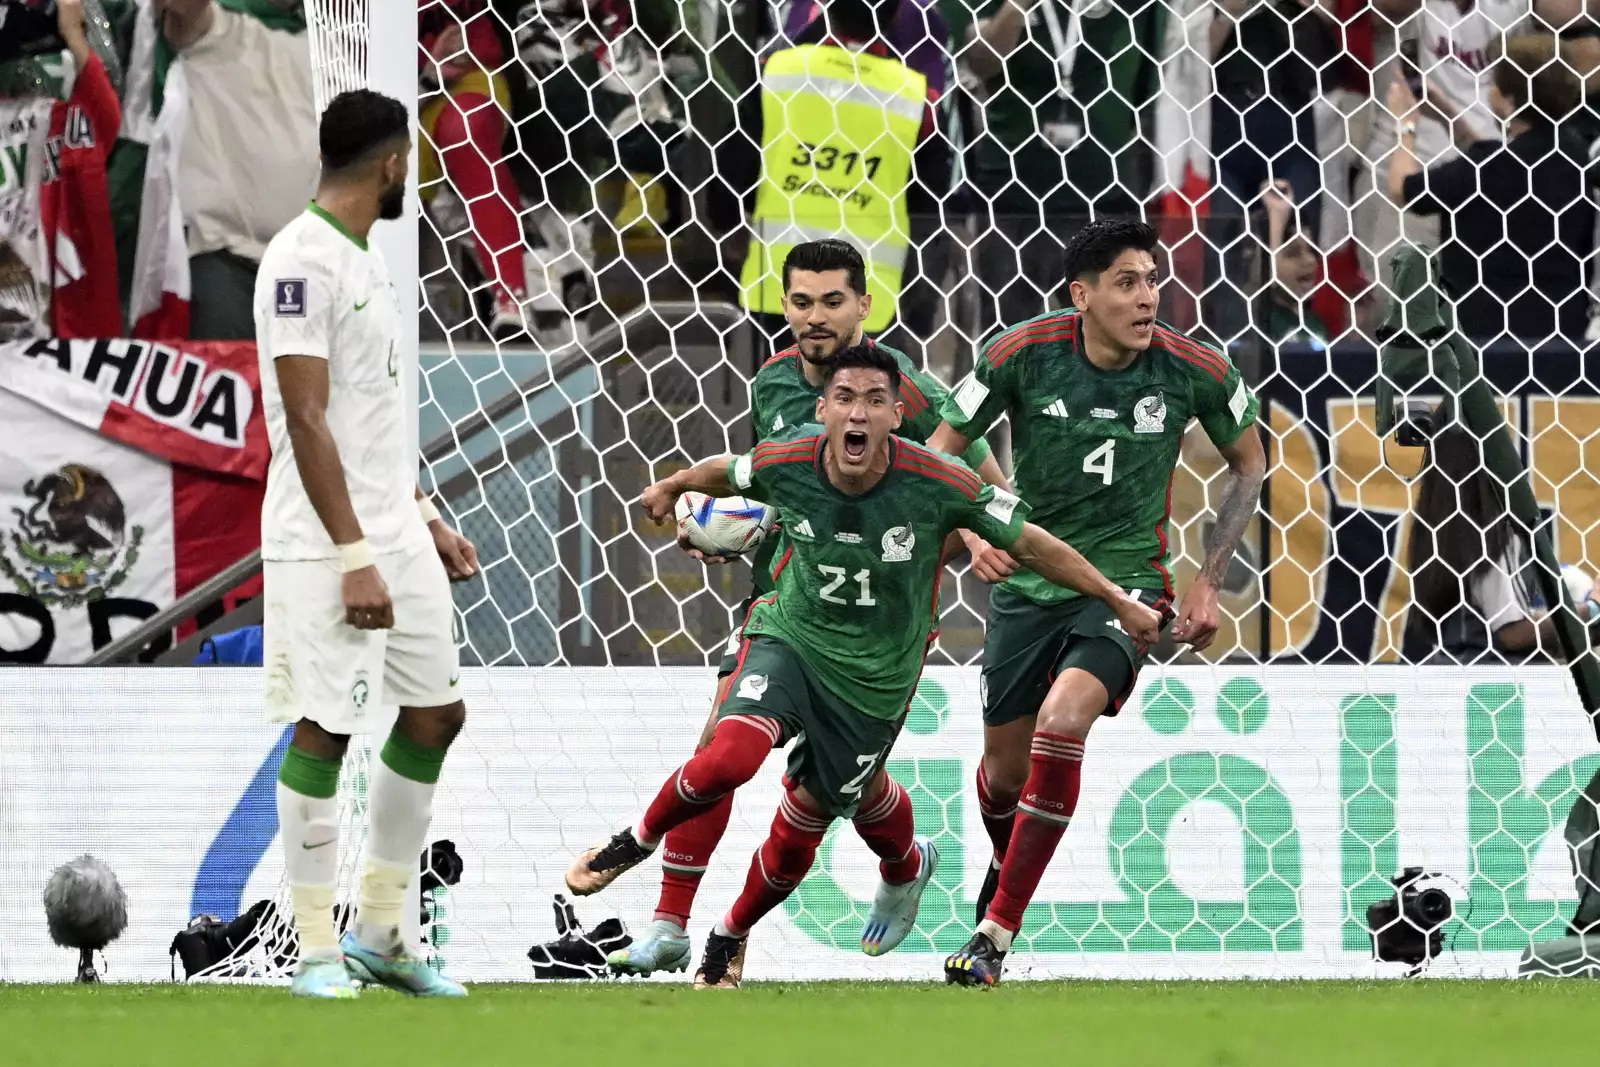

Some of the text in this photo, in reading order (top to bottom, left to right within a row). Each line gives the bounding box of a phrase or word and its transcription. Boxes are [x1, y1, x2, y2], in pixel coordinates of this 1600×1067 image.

[791, 141, 882, 180] 3311
[782, 174, 872, 210] Security
[1082, 438, 1116, 486] 4
[817, 563, 876, 606] 21
